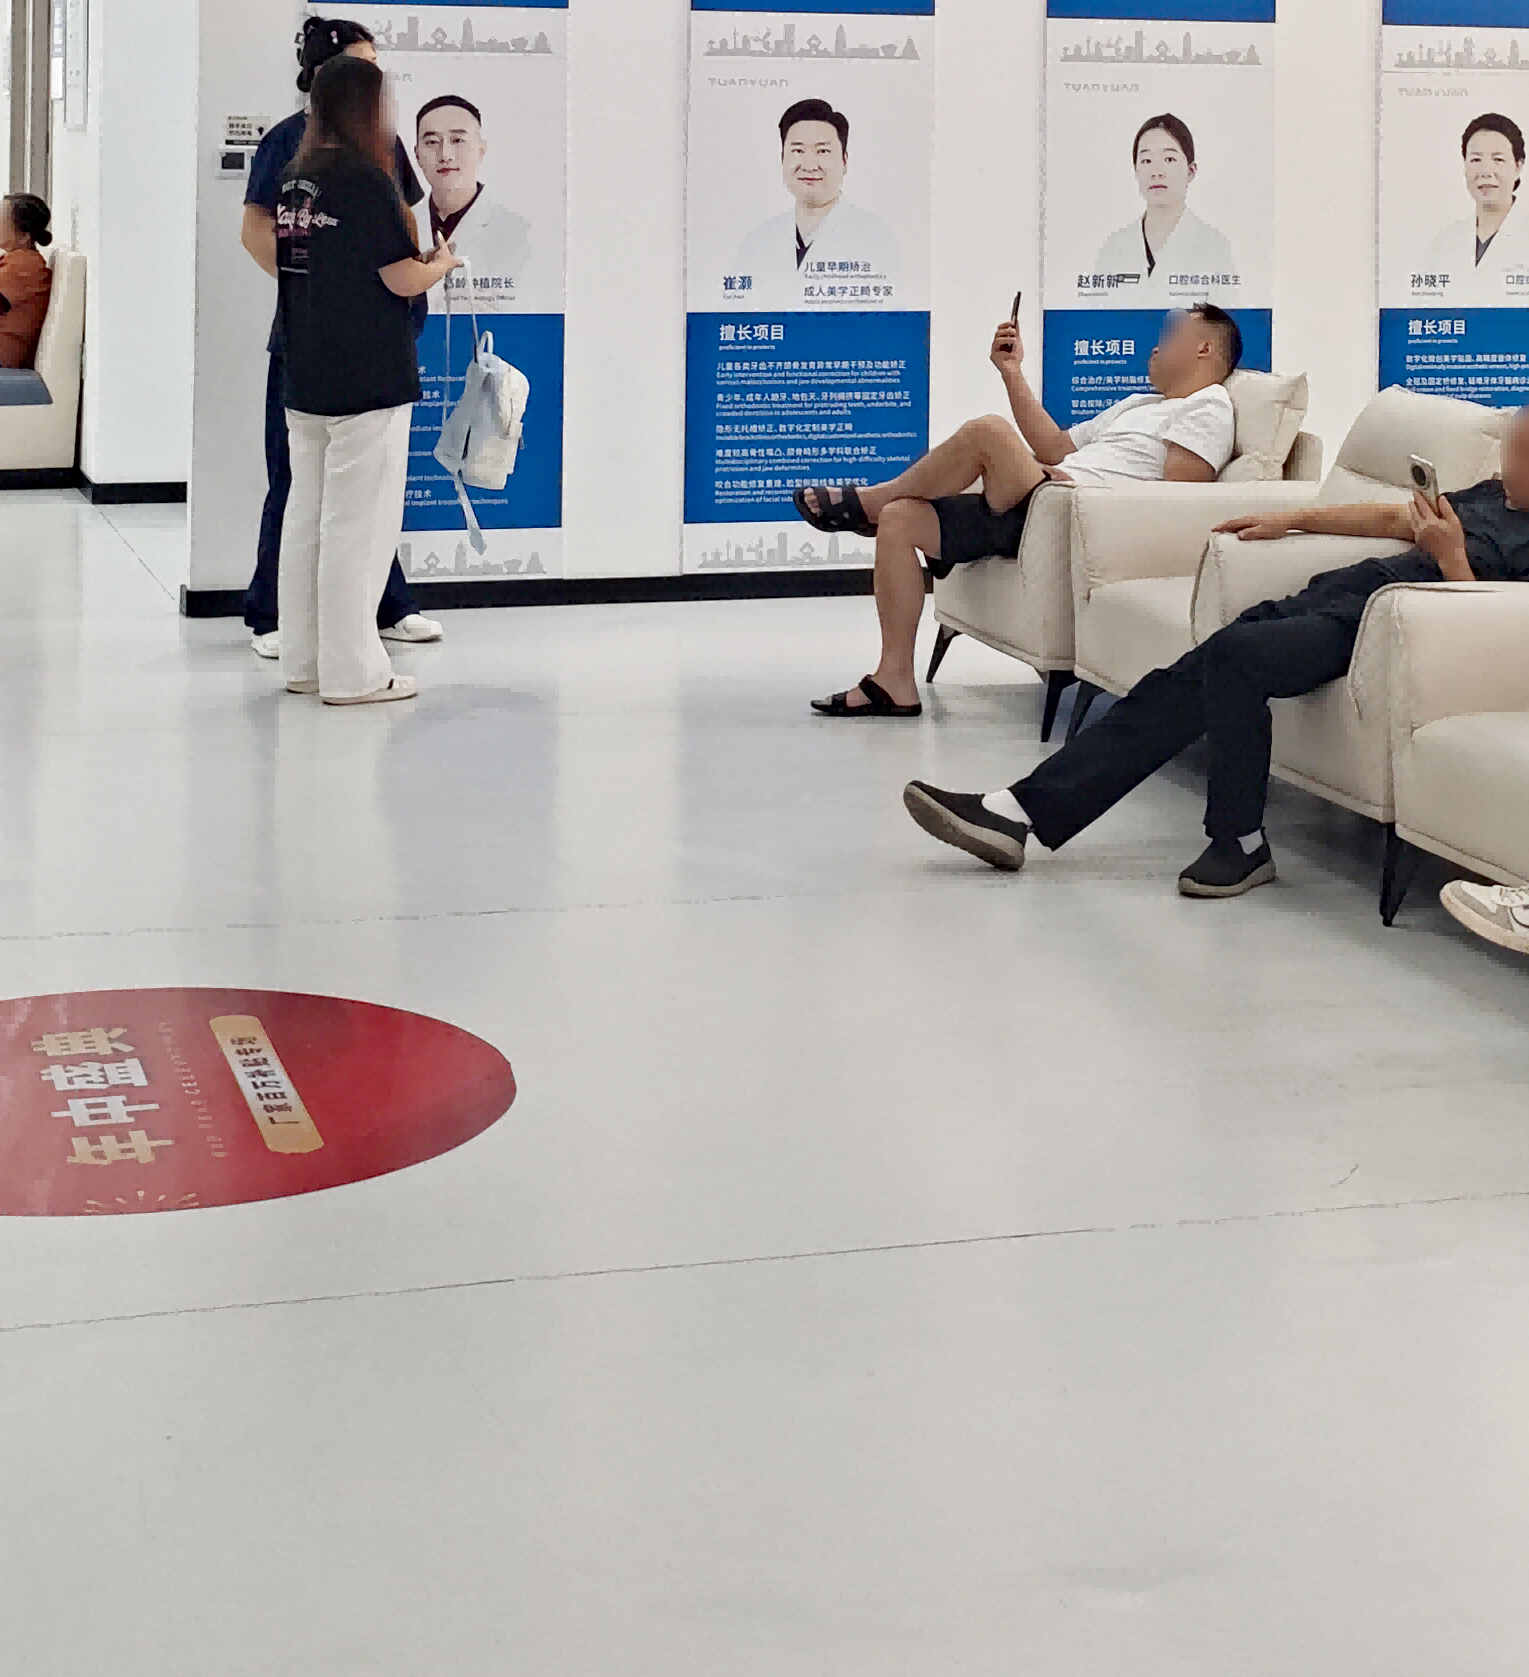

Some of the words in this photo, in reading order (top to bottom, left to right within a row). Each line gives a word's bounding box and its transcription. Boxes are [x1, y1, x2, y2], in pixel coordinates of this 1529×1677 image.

[805, 261, 871, 272] 儿童早期矫治
[1077, 274, 1119, 289] 赵新新
[1169, 274, 1241, 286] 口腔综合科医生
[1410, 273, 1450, 288] 孙晓平
[805, 285, 893, 297] 成人美学正畸专家
[720, 324, 784, 341] 擅长项目
[1408, 320, 1465, 335] 擅长项目
[1074, 340, 1134, 355] 擅长项目
[31, 1027, 174, 1165] 年中盛典
